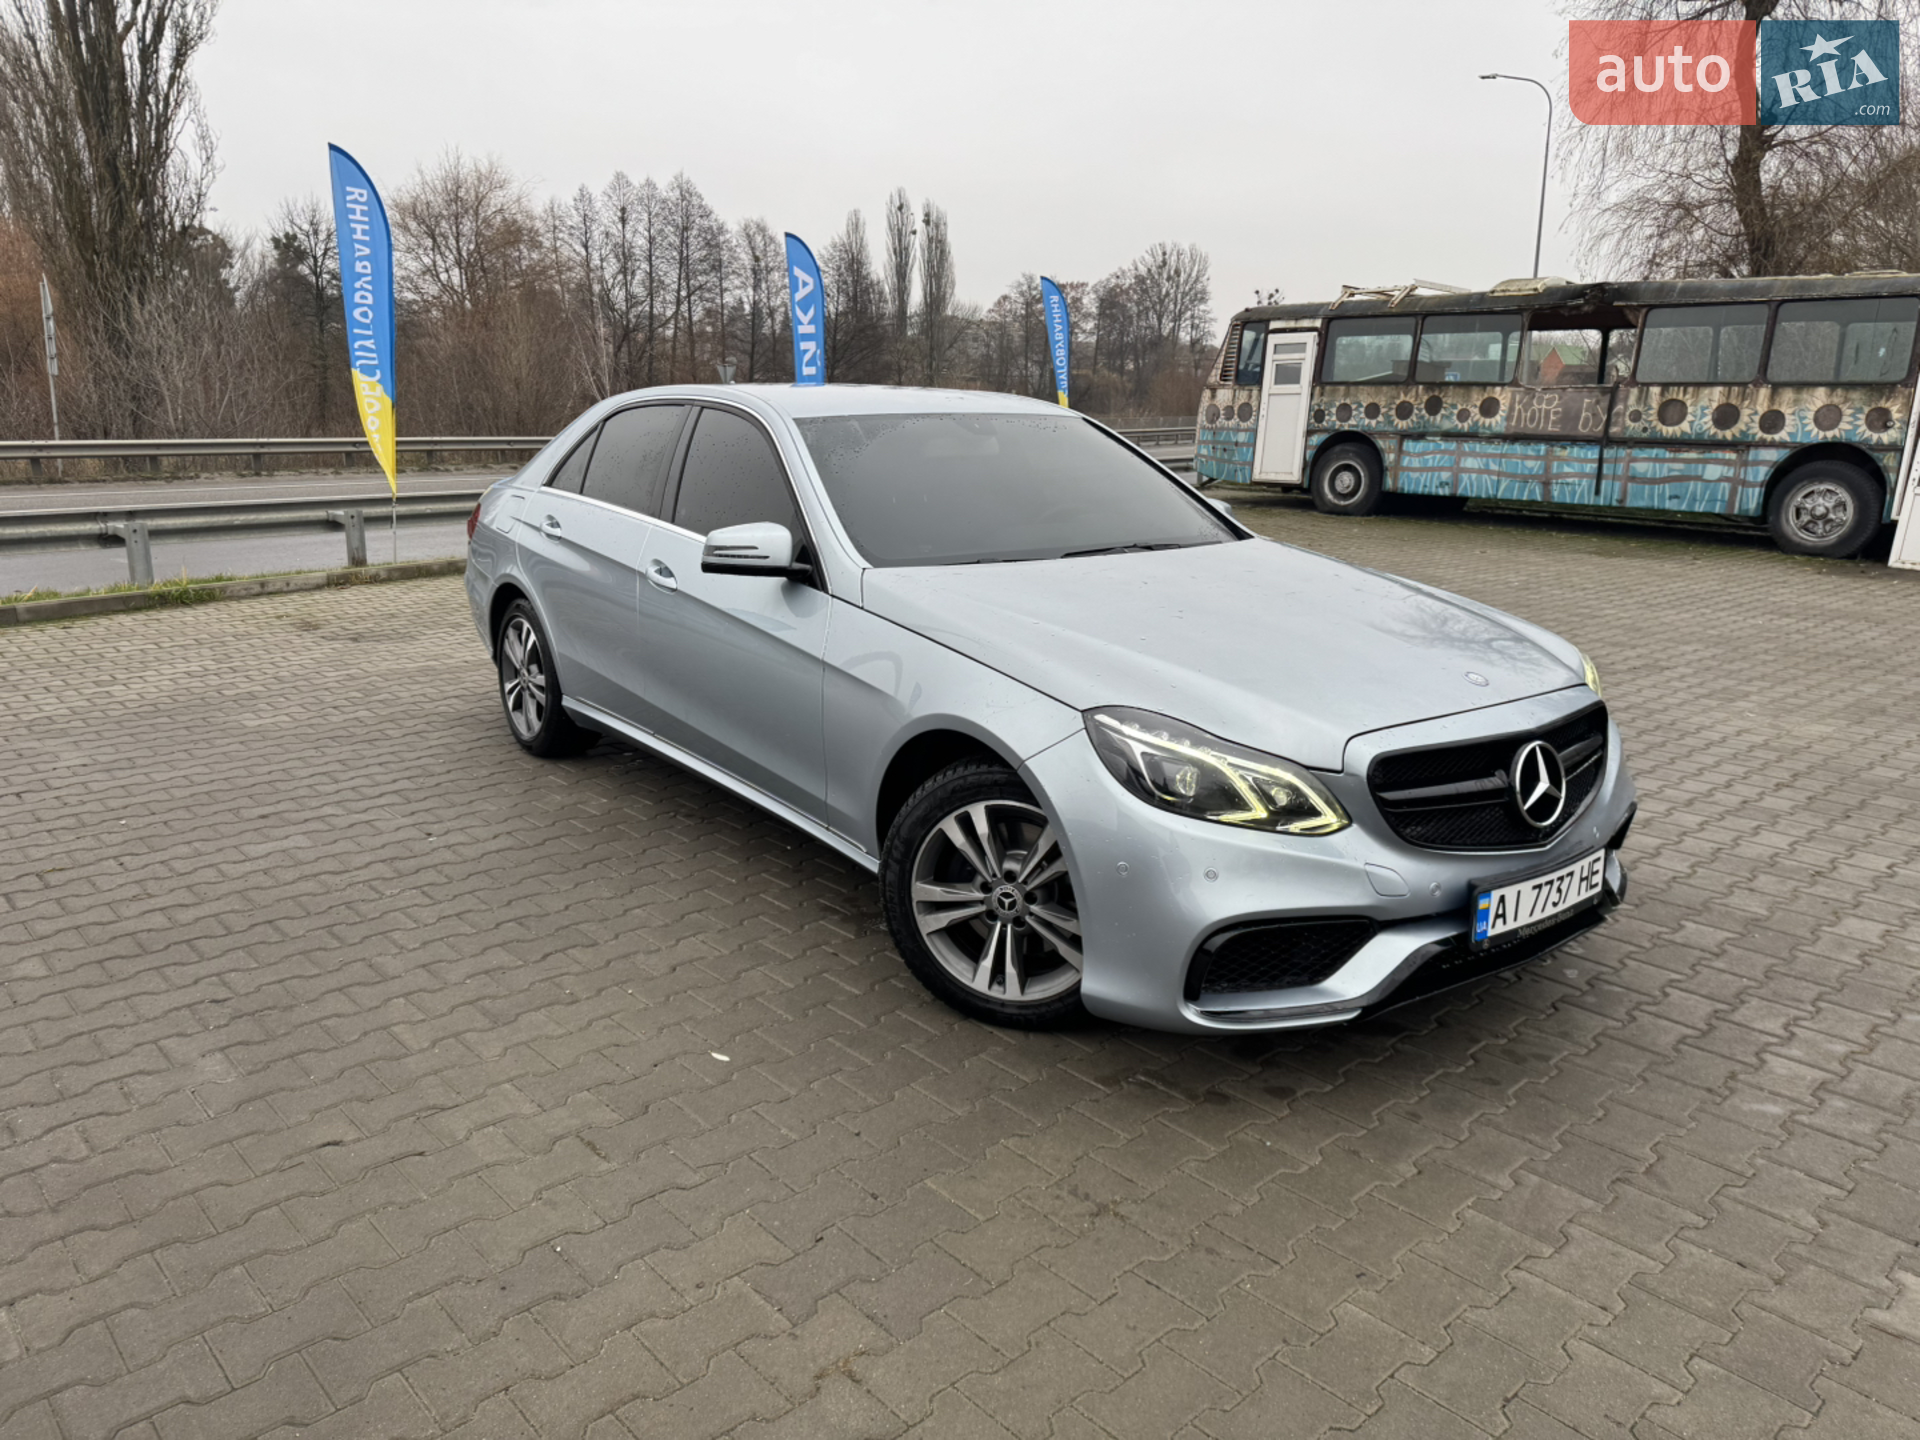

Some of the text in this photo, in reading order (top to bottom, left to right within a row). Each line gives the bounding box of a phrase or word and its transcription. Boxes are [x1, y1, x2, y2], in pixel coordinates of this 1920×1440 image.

[1510, 393, 1562, 432] КОФЕ
[1491, 857, 1602, 929] AI 7737 HE
